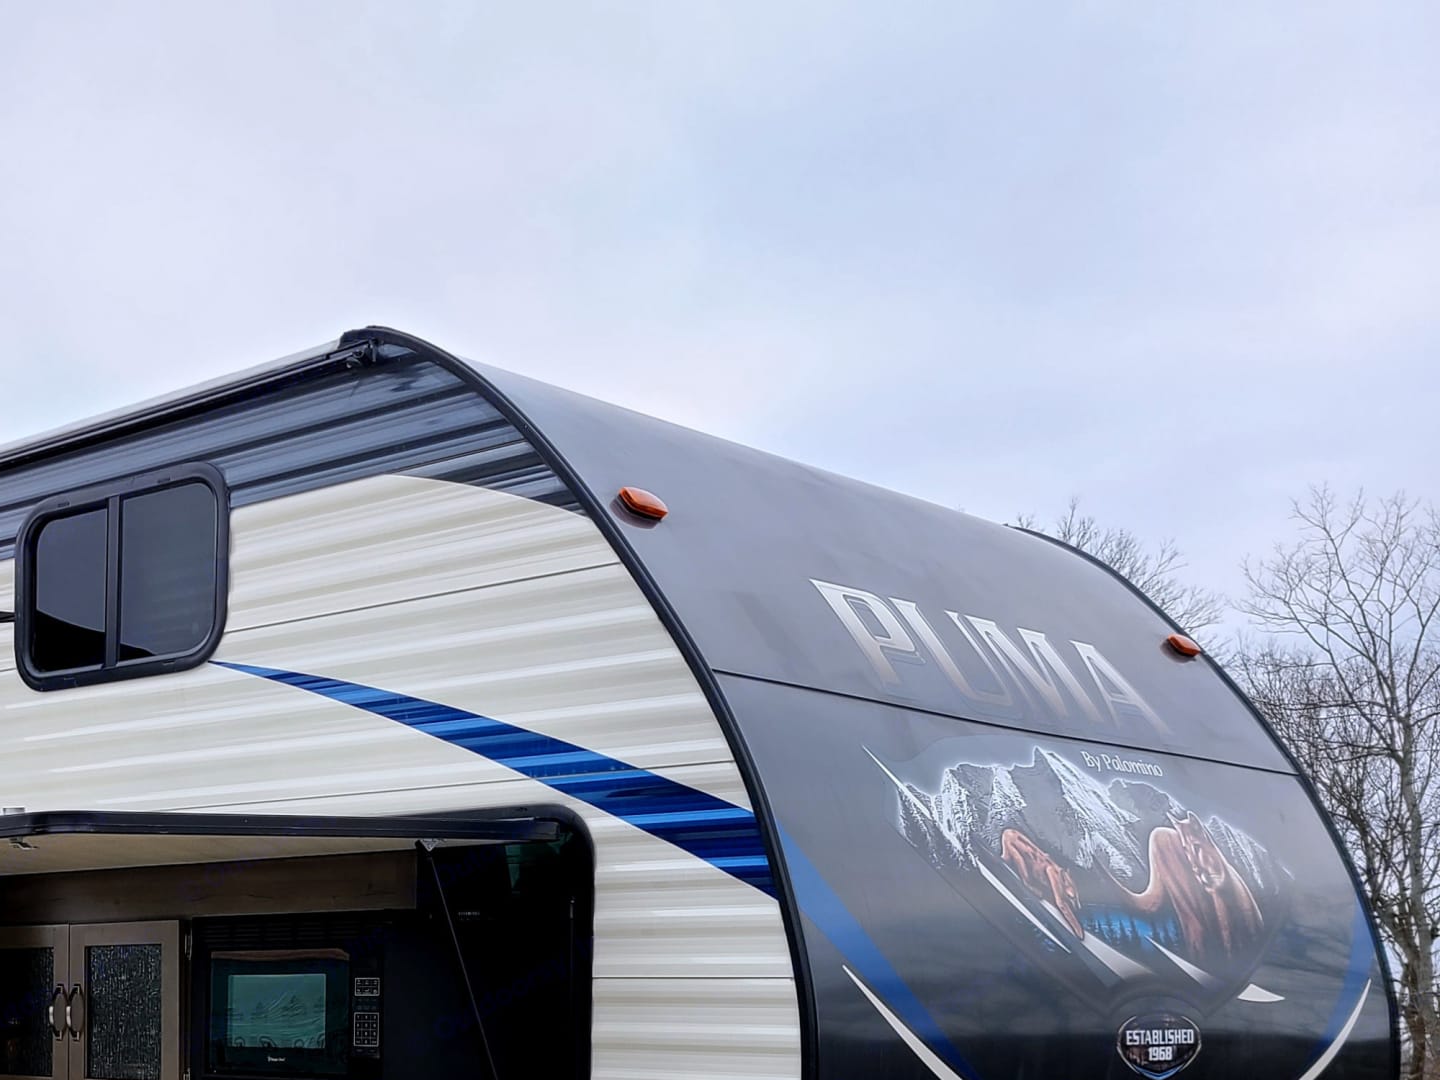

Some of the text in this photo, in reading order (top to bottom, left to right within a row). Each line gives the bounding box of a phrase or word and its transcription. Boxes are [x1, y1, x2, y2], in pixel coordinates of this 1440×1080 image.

[810, 578, 1172, 735] PUMA
[1081, 750, 1163, 777] By Palomino
[1125, 1029, 1195, 1046] ESTABLISHED
[1148, 1046, 1173, 1062] 1968
